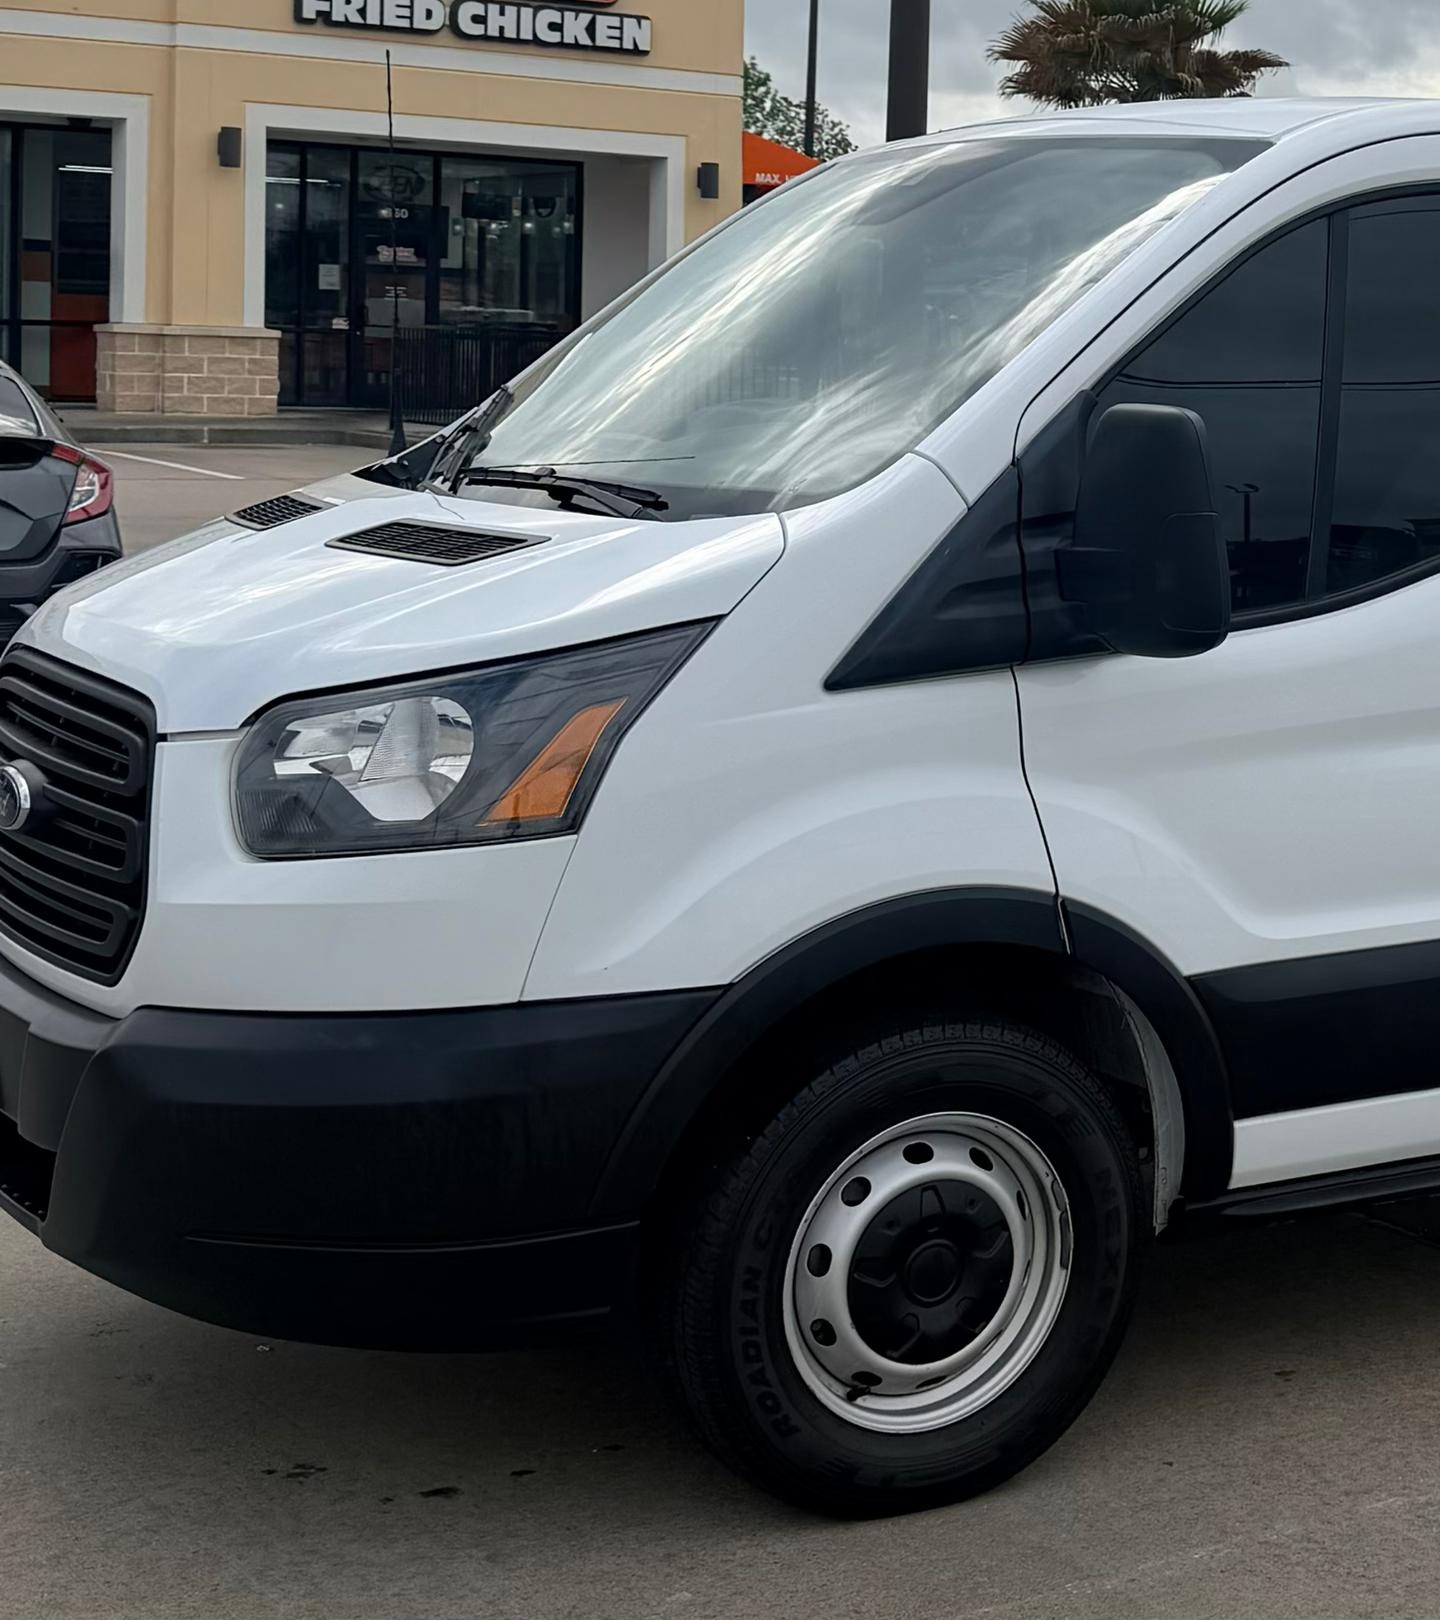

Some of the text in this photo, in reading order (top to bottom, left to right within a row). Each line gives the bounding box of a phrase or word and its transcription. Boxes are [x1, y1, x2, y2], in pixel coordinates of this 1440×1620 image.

[301, 0, 651, 50] FRIED CHICKEN
[738, 1265, 801, 1439] ROADIAN
